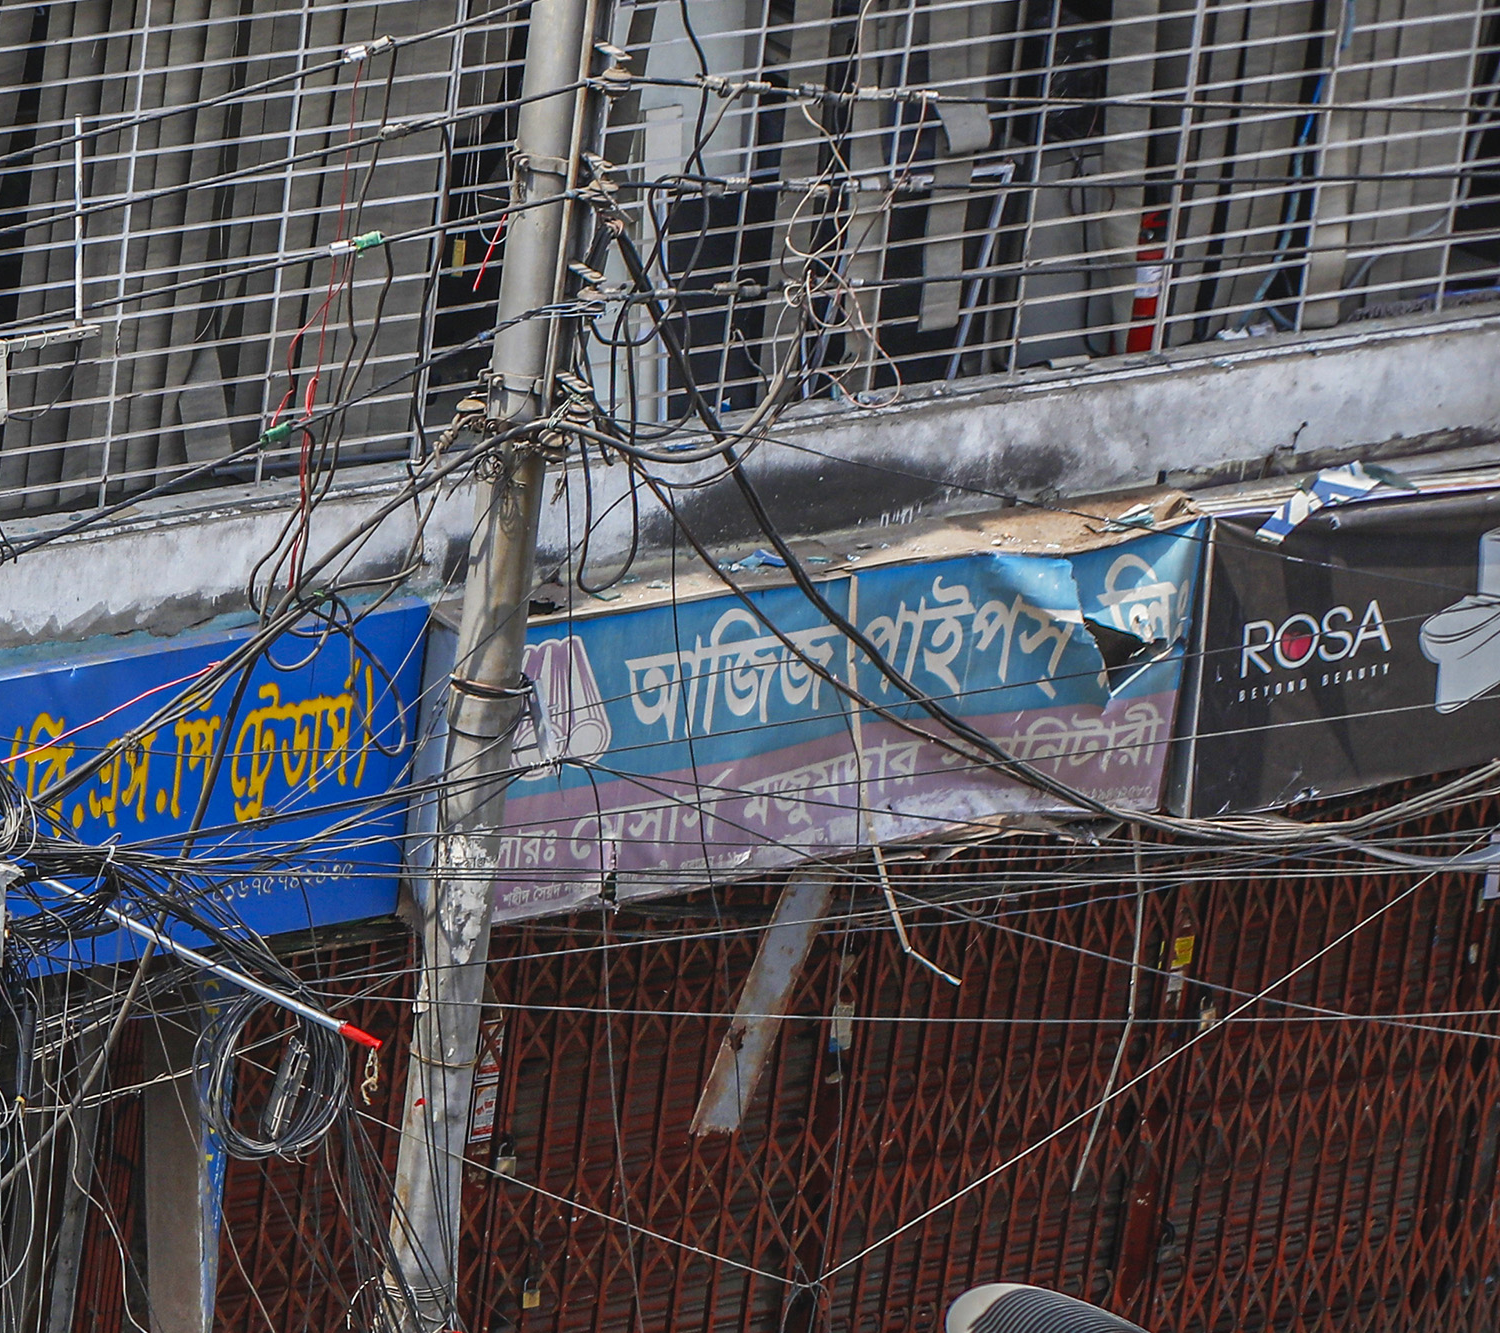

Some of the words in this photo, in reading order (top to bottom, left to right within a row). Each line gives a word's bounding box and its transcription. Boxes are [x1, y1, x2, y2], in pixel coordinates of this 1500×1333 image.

[625, 606, 842, 741] আজিজ
[1240, 599, 1392, 679] ROSA
[1238, 679, 1308, 703] BEYOND
[1321, 662, 1391, 687] BEAUTY
